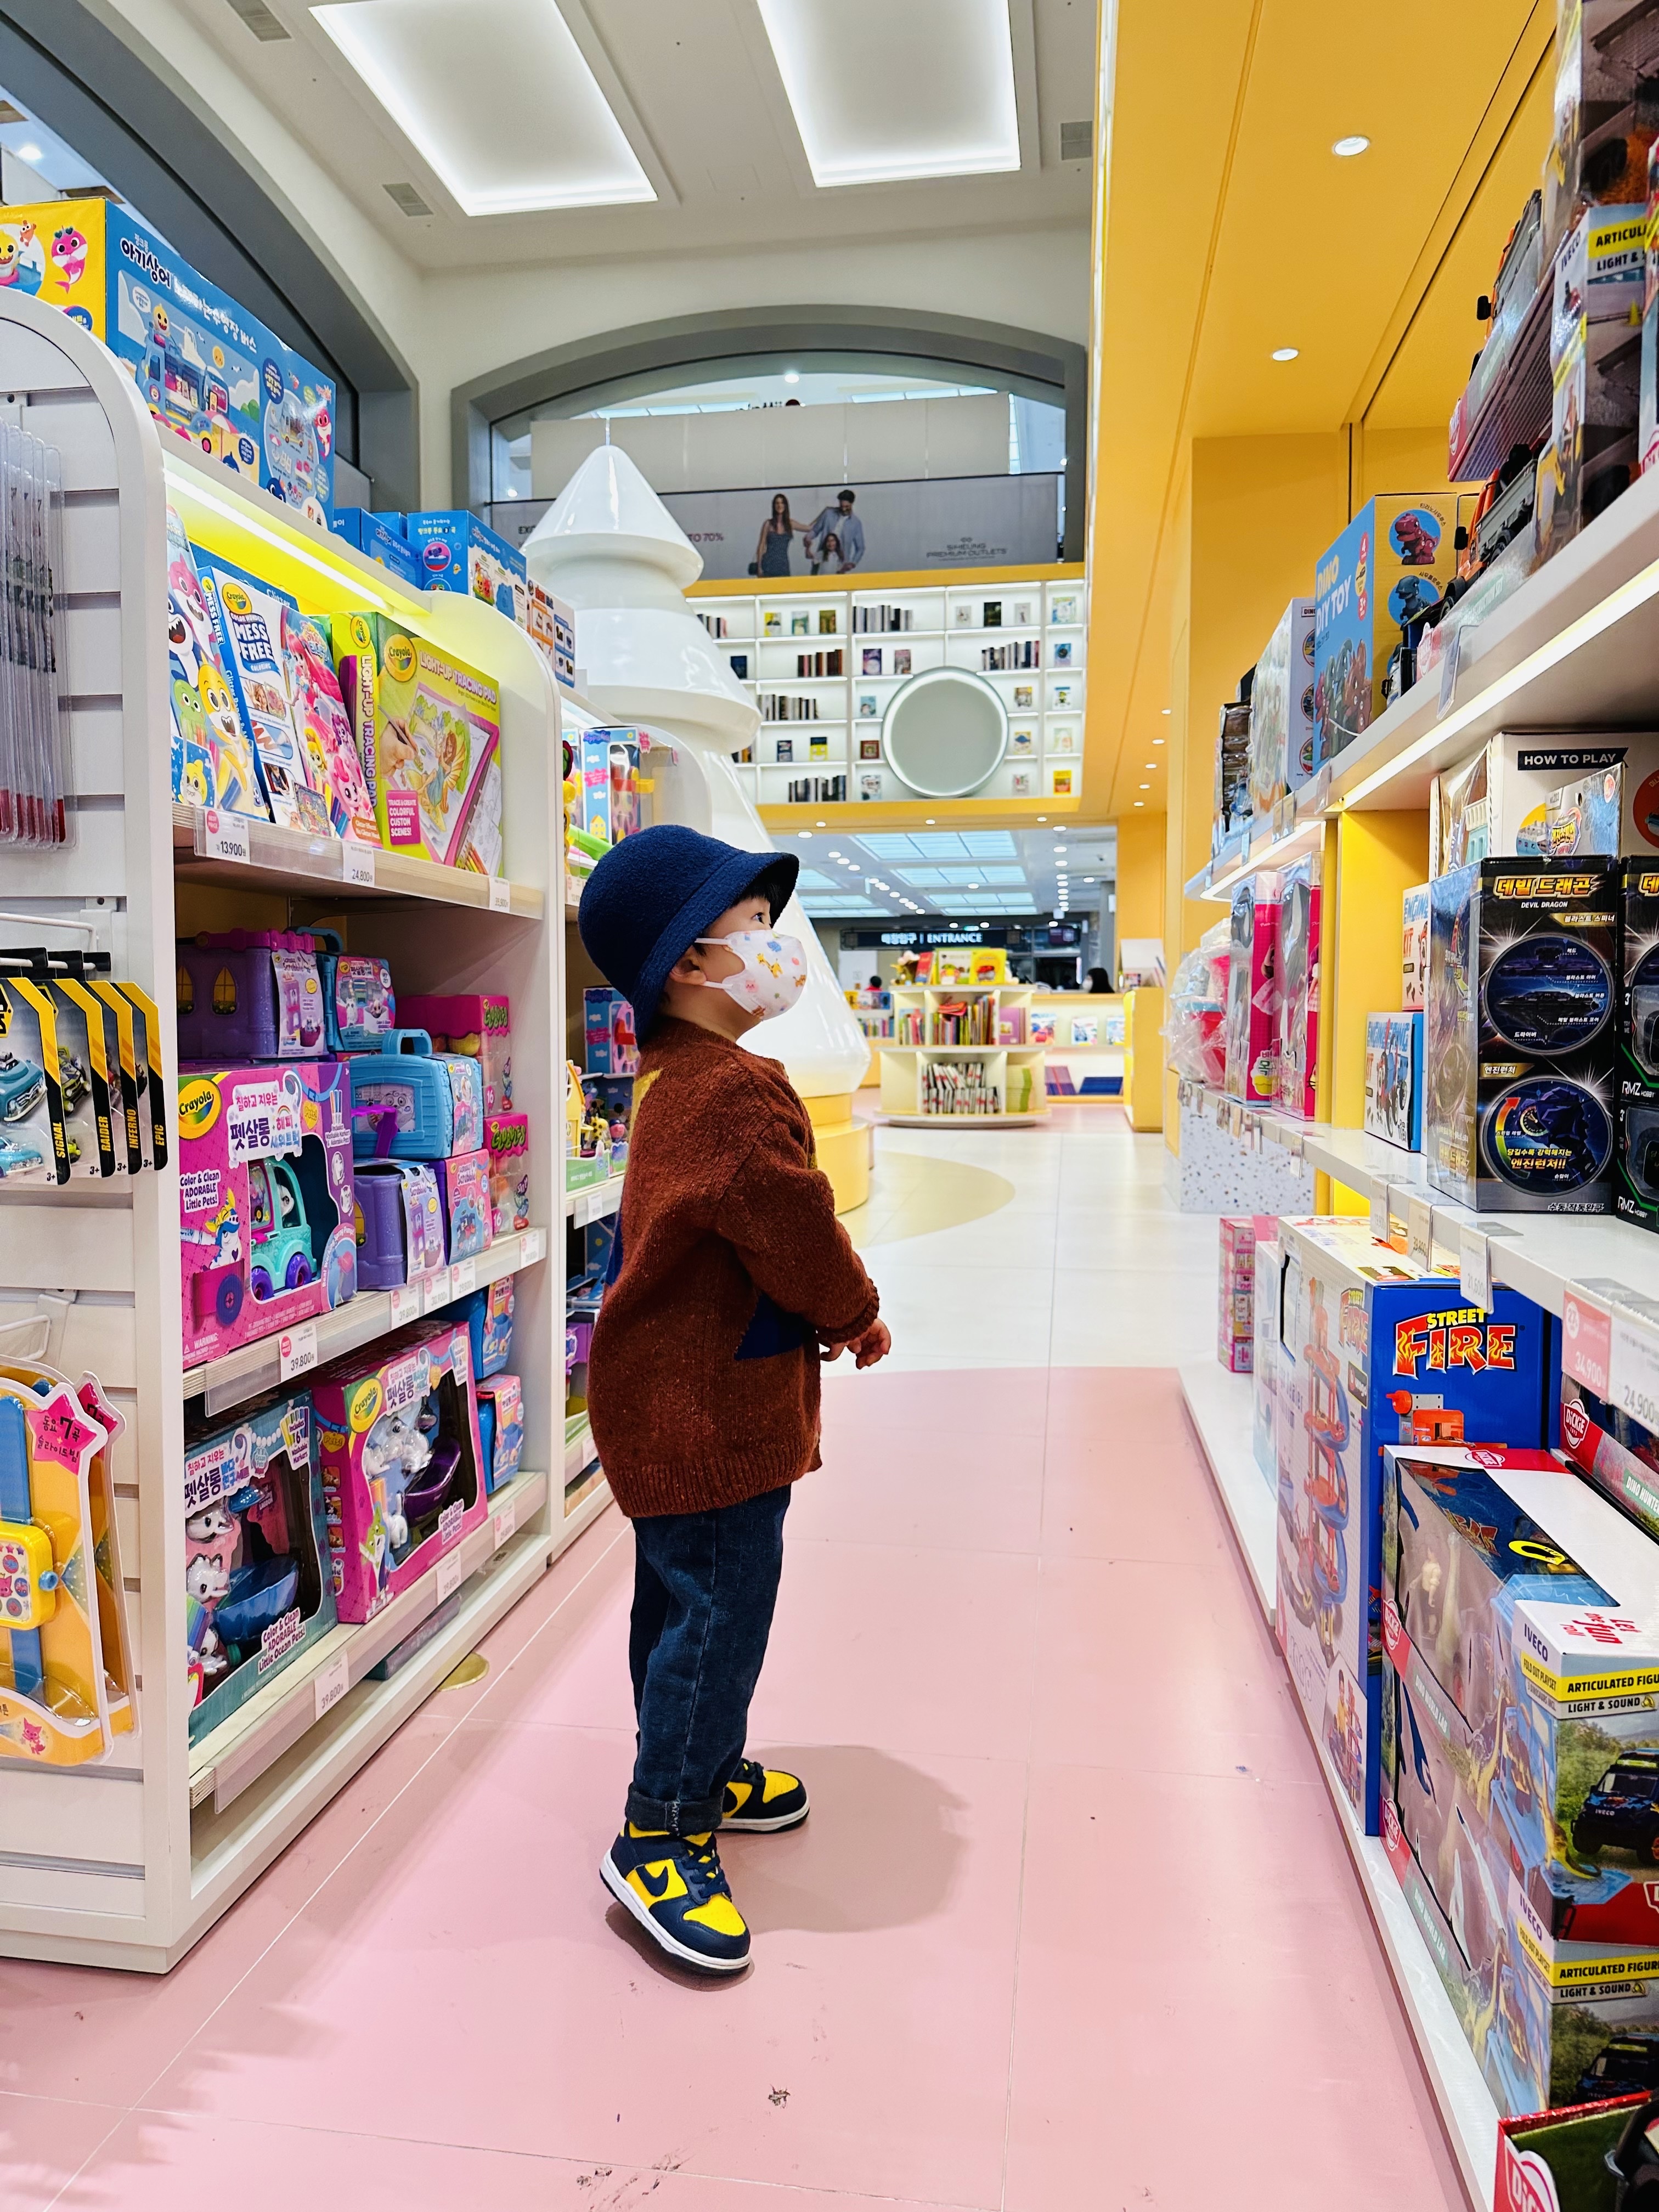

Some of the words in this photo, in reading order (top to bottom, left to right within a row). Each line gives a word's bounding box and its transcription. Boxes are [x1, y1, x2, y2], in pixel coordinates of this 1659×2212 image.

[1596, 224, 1646, 247] ARTICUL
[1561, 230, 1581, 273] IVECO
[1597, 253, 1627, 272] LIGHT
[1631, 252, 1639, 262] &
[120, 238, 172, 289] 아기상어
[240, 330, 258, 354] 버스
[703, 533, 724, 541] 70%
[1317, 555, 1340, 602] DINO
[227, 591, 246, 601] Crayola
[1316, 596, 1331, 637] DIY
[1331, 574, 1352, 621] TOY
[205, 592, 219, 618] MESS
[212, 617, 225, 645] FREE
[234, 622, 268, 641] MESS
[357, 619, 366, 644] Crayola
[239, 641, 273, 661] FREE
[389, 646, 411, 659] Crayola
[362, 655, 374, 717] LIGHT-UP
[419, 650, 453, 681] LIGHT-UP
[454, 668, 484, 695] TRACING
[483, 685, 496, 704] PAD
[363, 720, 376, 780] TRACING
[1524, 754, 1558, 765] HOW
[1561, 754, 1579, 764] TO
[1583, 753, 1616, 764] PLAY
[365, 780, 378, 808] PAD
[389, 807, 415, 816] COLORFUL
[390, 817, 411, 826] CUSTOM
[391, 827, 413, 837] SCENES!
[1494, 877, 1534, 898] 데빌
[1535, 876, 1594, 898] 드래곤
[1593, 914, 1615, 922] 스피너
[927, 932, 983, 943] ENTRANCE
[1484, 1065, 1516, 1075] 엔진런처
[487, 1090, 494, 1103] 16
[1622, 1081, 1641, 1096] RMZ
[179, 1090, 215, 1115] Crayola
[236, 1093, 257, 1111] 칠하고
[258, 1093, 278, 1107] 지우는
[101, 1116, 111, 1152] RAIDER
[128, 1108, 138, 1149] INFERNO
[155, 1124, 165, 1147] EPIC
[230, 1117, 270, 1151] 펫살롱
[276, 1114, 294, 1131] 해피
[53, 1121, 66, 1159] SIGNAL
[1507, 1148, 1535, 1156] 당길수록
[1537, 1148, 1572, 1156] 강력해지는
[90, 1166, 99, 1175] 3+
[117, 1163, 126, 1171] 3+
[143, 1159, 153, 1167] 3+
[1510, 1158, 1566, 1169] 엔진런처!!
[47, 1172, 55, 1181] 3+
[180, 1174, 197, 1186] Color
[198, 1173, 202, 1183] &
[204, 1171, 219, 1182] Clean
[184, 1183, 217, 1198] ADORABLE
[185, 1198, 201, 1210] Little
[202, 1194, 218, 1206] Pets!
[1547, 1203, 1567, 1212] 수동
[1567, 1203, 1605, 1212] 작동완구
[1617, 1195, 1635, 1214] RMZ
[493, 1212, 501, 1227] 16
[1347, 1288, 1364, 1307] STREET
[1339, 1290, 1369, 1356] FIRE
[1426, 1307, 1487, 1328] STREET
[194, 1333, 218, 1347] WARNING:
[1393, 1314, 1517, 1379] FIRE
[390, 1368, 403, 1384] 칠하고
[403, 1360, 417, 1373] 지우는
[354, 1385, 378, 1414] Crayola
[387, 1374, 414, 1408] 펫살롱
[43, 1415, 57, 1432] 동요
[60, 1416, 80, 1442] 7곡
[289, 1420, 305, 1432] Includes
[1565, 1408, 1585, 1435] DiCKiE
[296, 1431, 301, 1444] 6
[324, 1435, 343, 1447] Pets!
[37, 1435, 80, 1463] 슬라이드빔
[293, 1452, 308, 1464] Markers
[187, 1457, 206, 1476] 칠하고
[207, 1448, 225, 1465] 지우는
[184, 1466, 221, 1509] 펫살롱
[1626, 1475, 1640, 1497] DINO
[263, 1626, 278, 1643] Color
[279, 1620, 283, 1631] &
[284, 1609, 299, 1626] Clean
[1584, 1612, 1605, 1623] the
[1609, 1619, 1642, 1633] Let
[268, 1621, 297, 1651] ADORABLE
[1560, 1623, 1587, 1637] roll
[1572, 1620, 1623, 1644] fun
[259, 1654, 274, 1672] Little
[274, 1640, 291, 1659] Ocean
[291, 1627, 306, 1645] Pets!
[1524, 1623, 1548, 1662] IVECO
[1523, 1658, 1533, 1673] FOLD
[1539, 1670, 1557, 1691] PLAYSET
[1567, 1676, 1634, 1694] ARTICULATED
[1415, 1674, 1425, 1697] DINO
[1424, 1691, 1438, 1718] WORLD
[1437, 1711, 1448, 1734] LAB
[1568, 1701, 1595, 1713] LIGHT
[1598, 1700, 1605, 1710] &
[1608, 1697, 1640, 1709] SOUND
[1519, 1893, 1543, 1941] IVECO
[1560, 1962, 1625, 1979] ARTICULATED
[1560, 1986, 1587, 1998] LIGHT
[1589, 1985, 1596, 1996] &
[1599, 1982, 1631, 1995] SOUND
